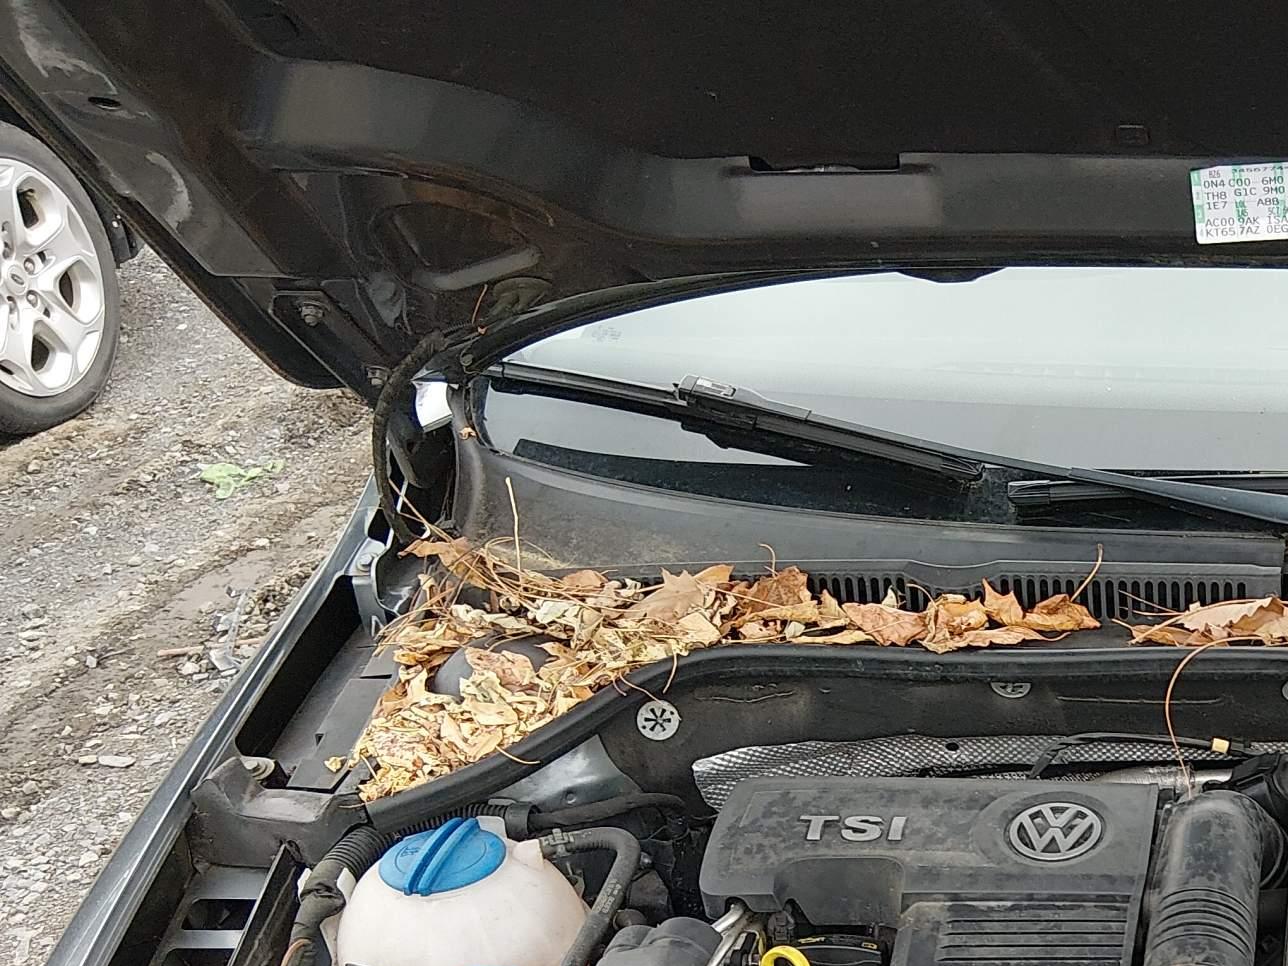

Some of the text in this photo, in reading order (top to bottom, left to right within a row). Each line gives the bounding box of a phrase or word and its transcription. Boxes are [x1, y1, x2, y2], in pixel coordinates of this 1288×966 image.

[1204, 178, 1225, 189] 0N4
[1228, 178, 1250, 188] C00
[1262, 176, 1284, 186] 6M0
[1204, 191, 1227, 201] TH8
[1234, 186, 1256, 197] G1C
[1263, 186, 1286, 196] 9M0
[1206, 202, 1227, 210] 1E7
[1205, 217, 1235, 228] AC00
[1237, 216, 1260, 227] 9AK
[1267, 214, 1288, 224] 1SA
[1206, 226, 1236, 238] KT65
[1240, 225, 1260, 236] 7AZ
[1266, 224, 1288, 234] 0EG
[799, 815, 907, 842] TSI
[1009, 801, 1101, 861] VW
